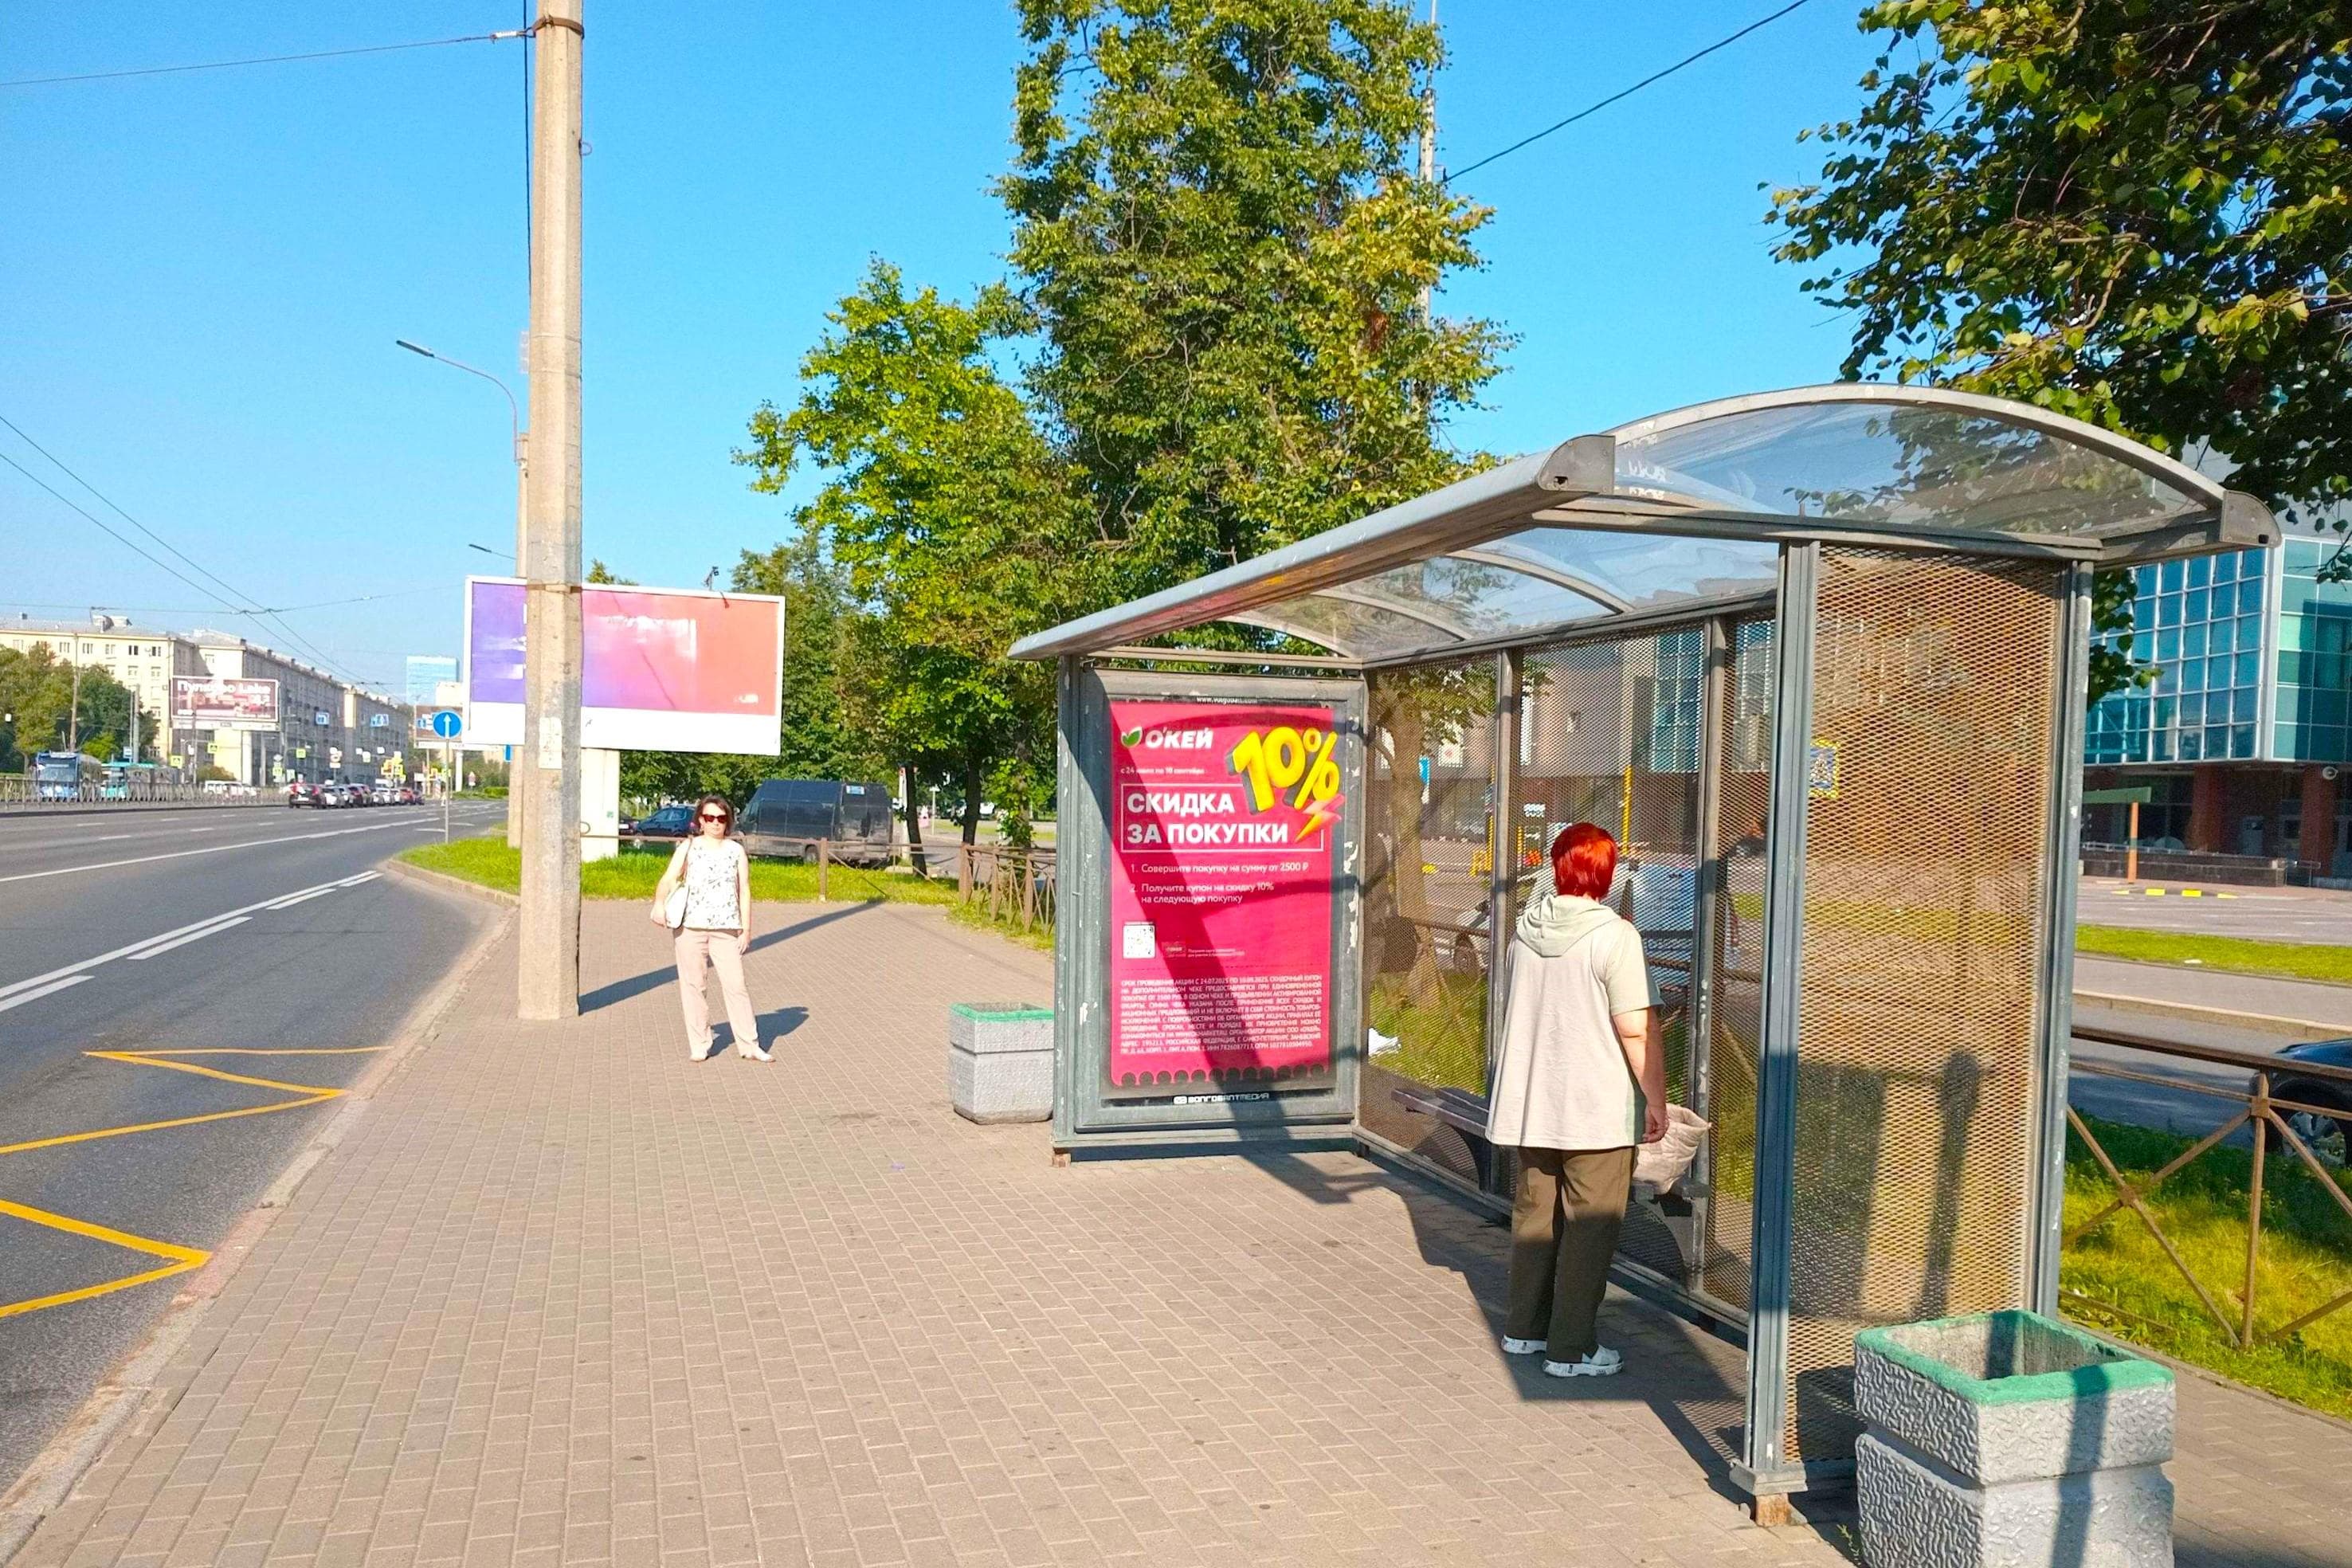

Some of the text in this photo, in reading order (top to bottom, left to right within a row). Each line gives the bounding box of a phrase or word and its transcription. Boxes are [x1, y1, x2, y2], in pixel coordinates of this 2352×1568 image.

[1228, 726, 1340, 813] 10%
[1127, 793, 1234, 817] СКИДКА
[1127, 823, 1288, 844] ЗА ПОКУПКИ
[1131, 864, 1138, 873] 1.
[1141, 864, 1192, 874] Совершите
[1193, 864, 1229, 875] покупку
[1241, 864, 1268, 874] сумму
[1280, 862, 1301, 872] 2500
[1141, 883, 1185, 894] Получите
[1186, 884, 1213, 894] купон
[1225, 884, 1256, 892] скидку
[1256, 881, 1275, 891] 10%
[1153, 896, 1206, 905] следующую
[1207, 896, 1243, 904] покупку
